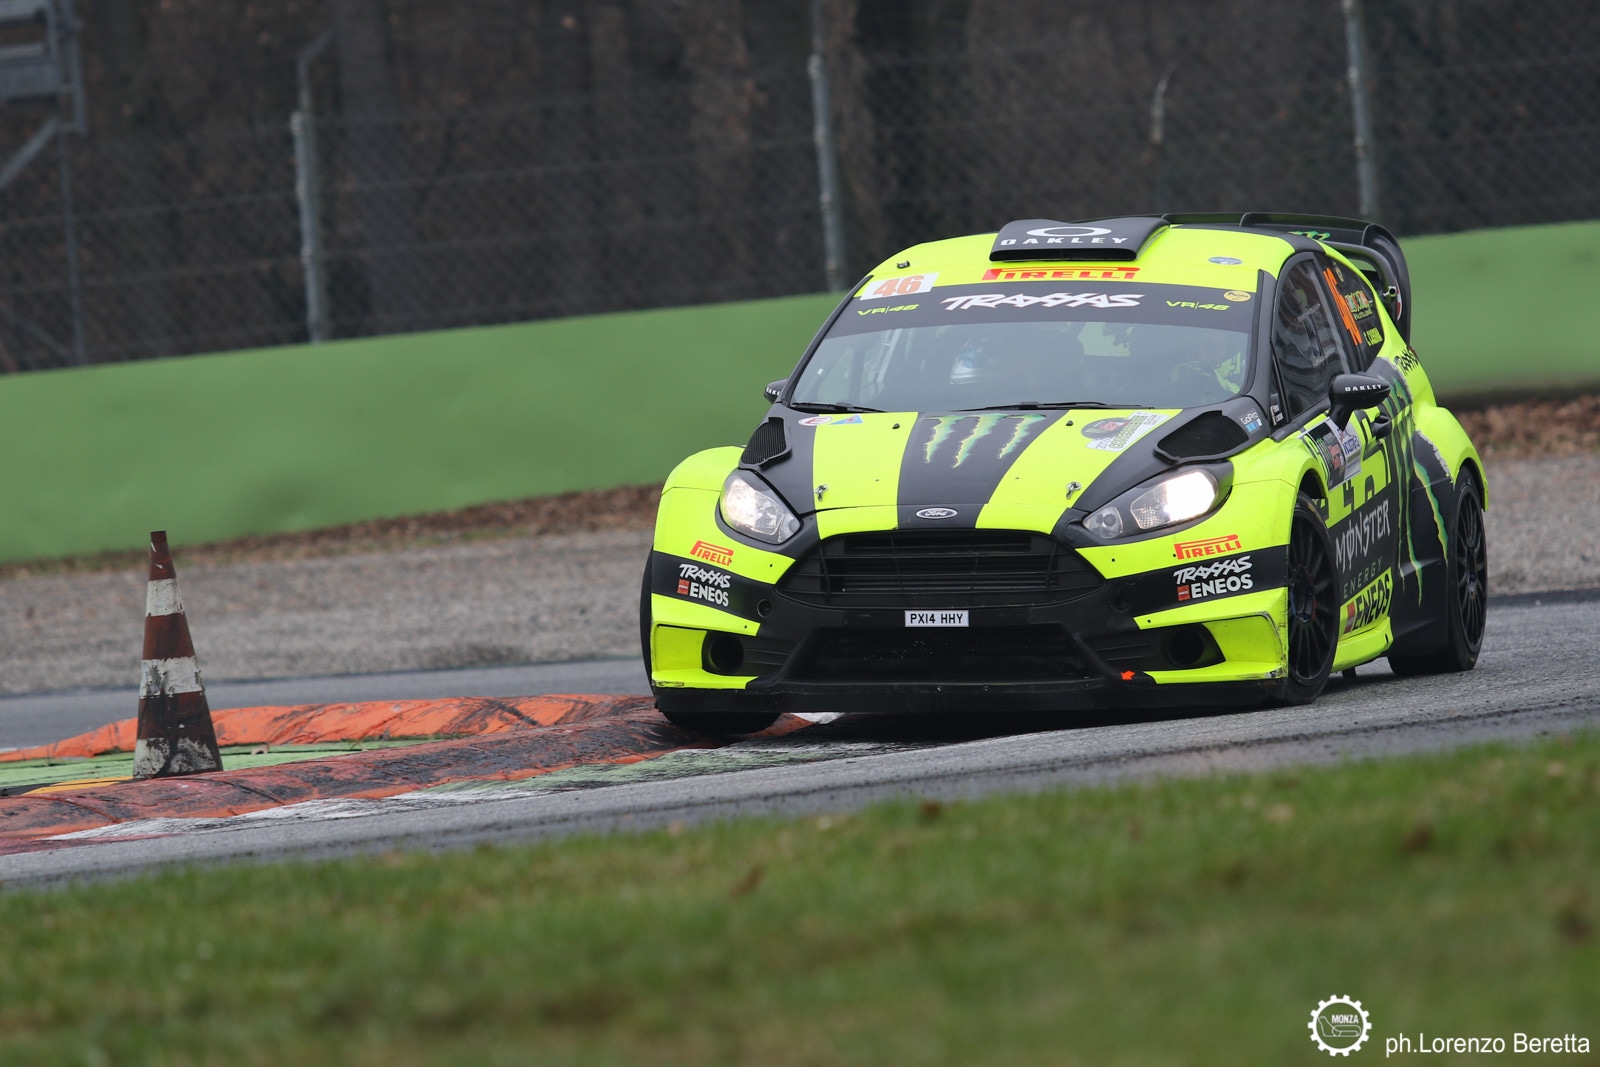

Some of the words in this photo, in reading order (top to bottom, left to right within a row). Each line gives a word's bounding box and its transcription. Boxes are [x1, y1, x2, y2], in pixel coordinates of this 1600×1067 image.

[1000, 237, 1128, 246] OAKLEY
[981, 266, 1141, 281] PIRELLI
[872, 275, 925, 298] 46
[939, 292, 1146, 311] TRAXXAS
[1344, 384, 1383, 393] OAKLEY
[1240, 411, 1259, 425] GoPro
[924, 509, 948, 517] Ford
[1173, 534, 1242, 560] PIRELLI
[1335, 499, 1391, 574] MONSTER
[690, 539, 735, 567] PIRELLI
[679, 563, 731, 589] TRAXXAS
[1173, 555, 1253, 585] TRAXXAS
[1343, 556, 1383, 600] ENERGY
[689, 582, 729, 607] ENEOS
[1190, 573, 1254, 599] ENEOS
[1352, 573, 1390, 631] ENEOS
[910, 613, 936, 624] PX14
[940, 613, 964, 624] HHY
